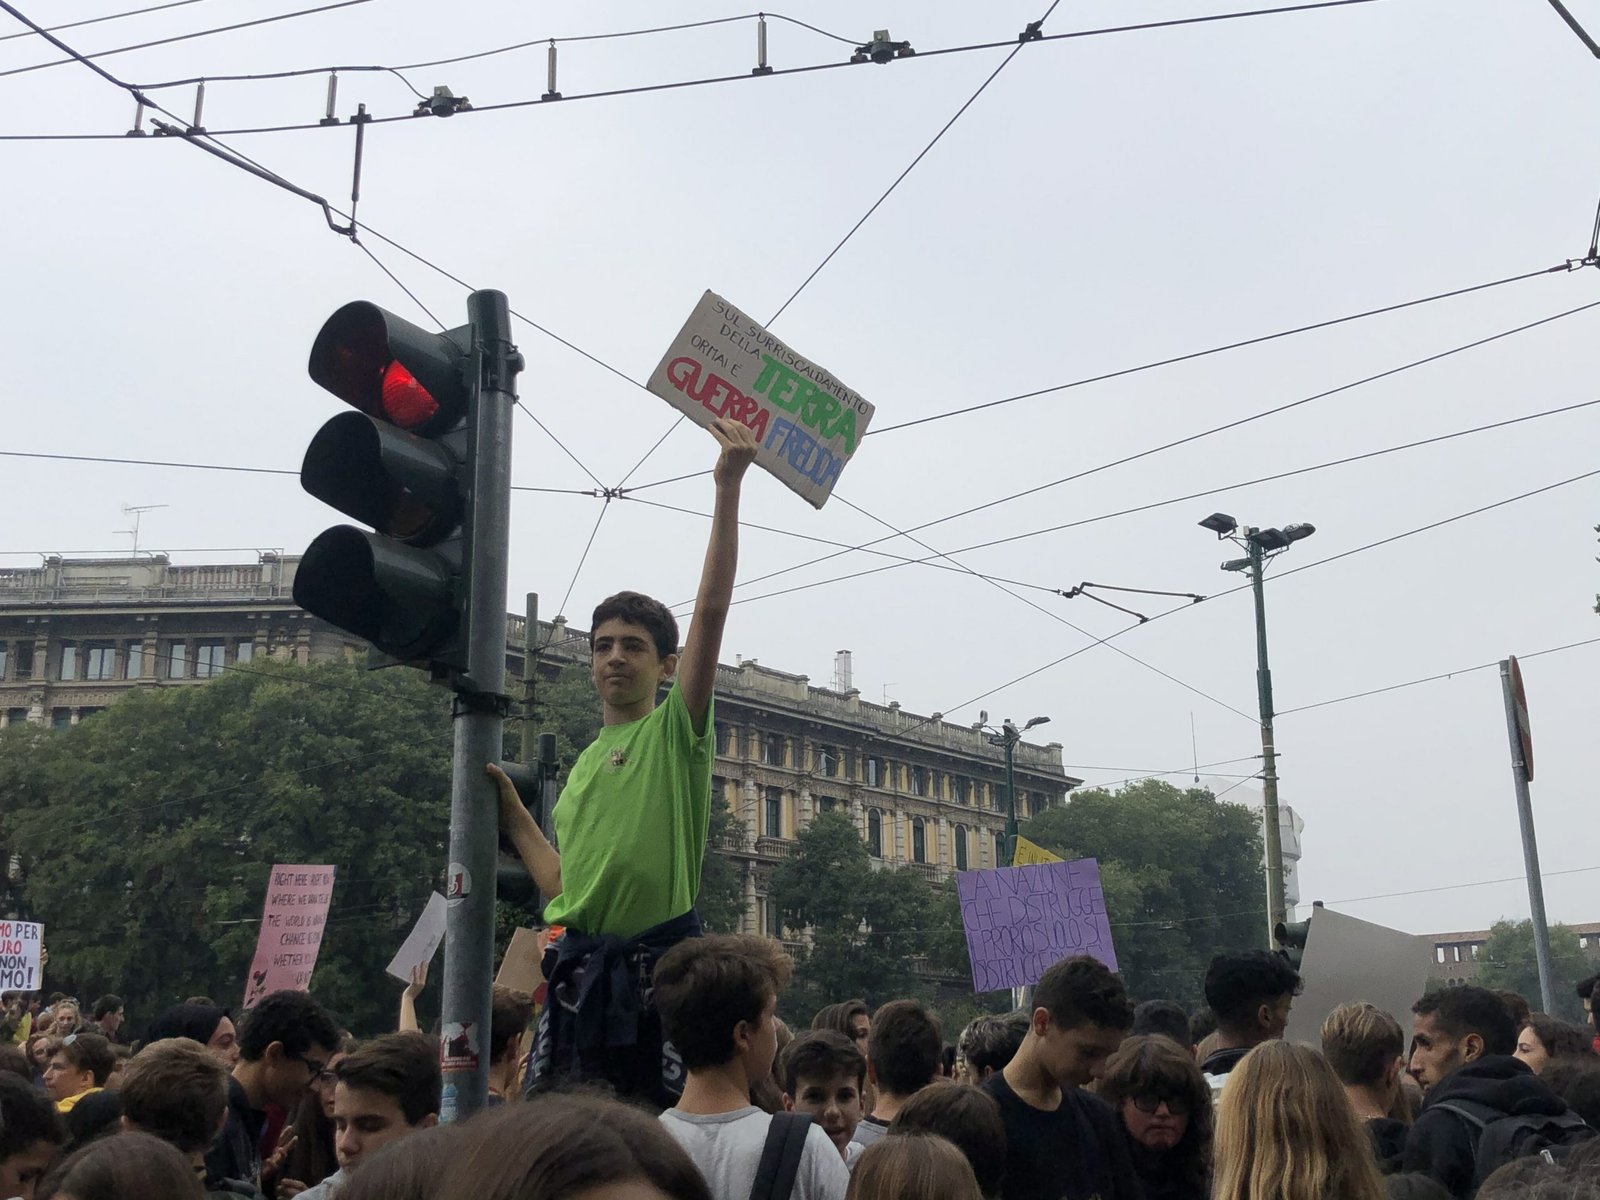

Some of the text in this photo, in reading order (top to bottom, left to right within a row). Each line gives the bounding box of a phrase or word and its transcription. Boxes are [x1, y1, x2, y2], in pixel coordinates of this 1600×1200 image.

[691, 334, 729, 369] ORMAI
[712, 301, 869, 416] SUL SURRISCALDAMENTO
[719, 323, 857, 455] DELLA TERRA
[666, 356, 843, 493] GUERRA FREDDA
[15, 923, 38, 939] PER
[963, 897, 1001, 932] CHE
